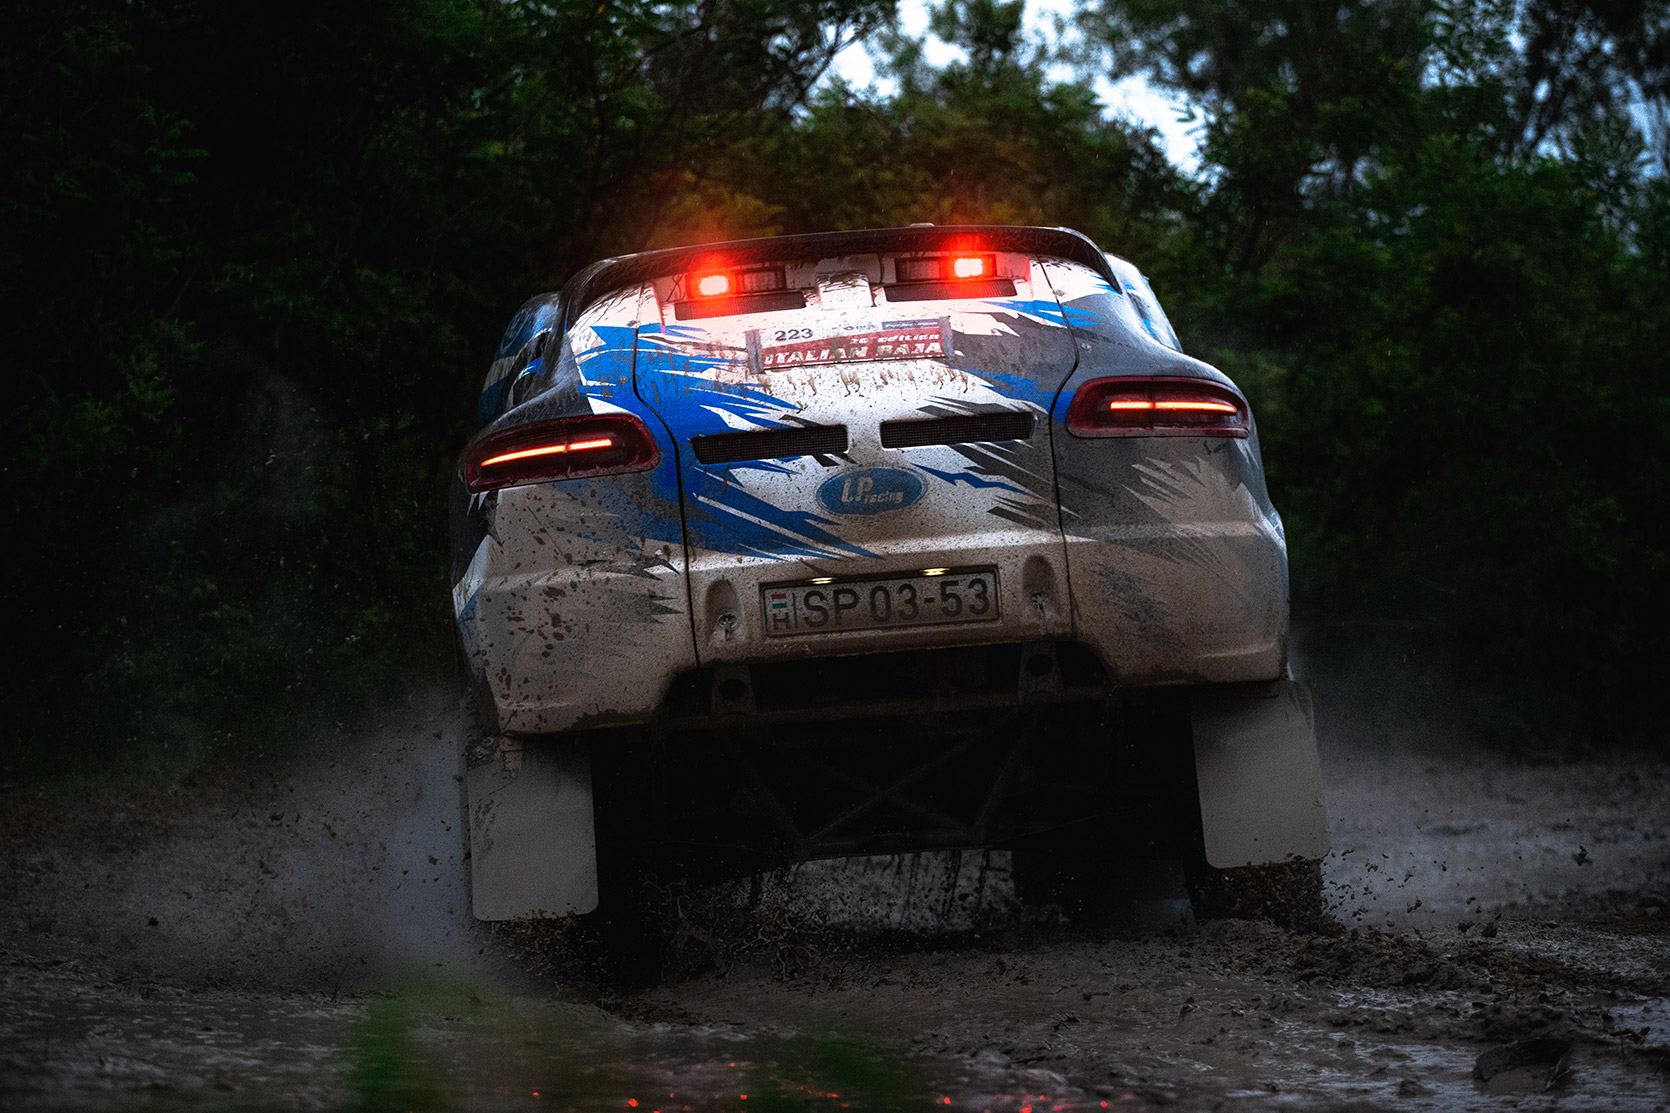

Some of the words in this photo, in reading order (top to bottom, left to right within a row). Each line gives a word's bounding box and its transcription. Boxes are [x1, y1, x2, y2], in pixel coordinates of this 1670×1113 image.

[775, 328, 813, 341] 223
[877, 334, 940, 343] edition
[763, 347, 868, 365] ITALIAN
[875, 342, 943, 357] BAJA
[864, 490, 904, 504] racing
[803, 588, 859, 628] SP
[870, 578, 990, 622] 03-53
[773, 612, 790, 630] H
